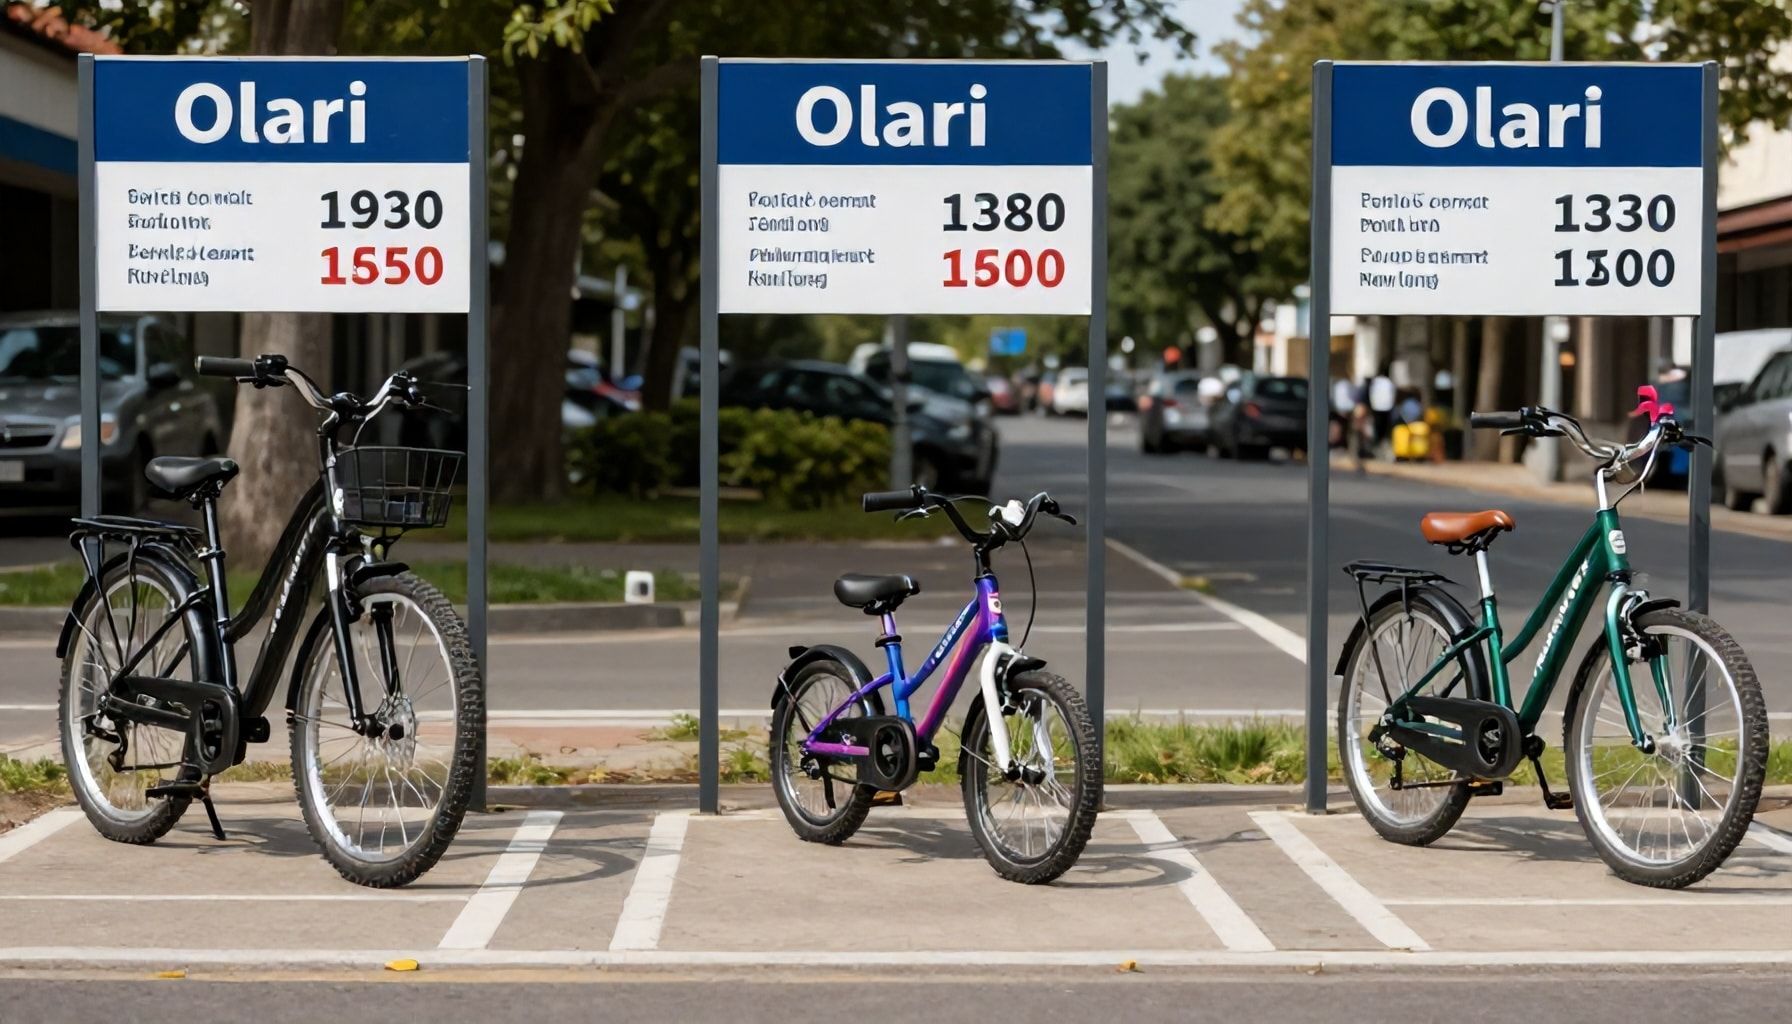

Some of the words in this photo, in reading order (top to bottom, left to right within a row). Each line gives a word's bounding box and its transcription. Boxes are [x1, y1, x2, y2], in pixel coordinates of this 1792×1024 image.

[174, 80, 367, 144] Olari
[795, 83, 987, 148] Olari
[1410, 85, 1603, 149] Olari
[320, 189, 443, 230] 1930
[943, 192, 1066, 232] 1380
[1554, 193, 1676, 233] 1330
[320, 246, 444, 286] 1550
[943, 248, 1065, 288] 1500
